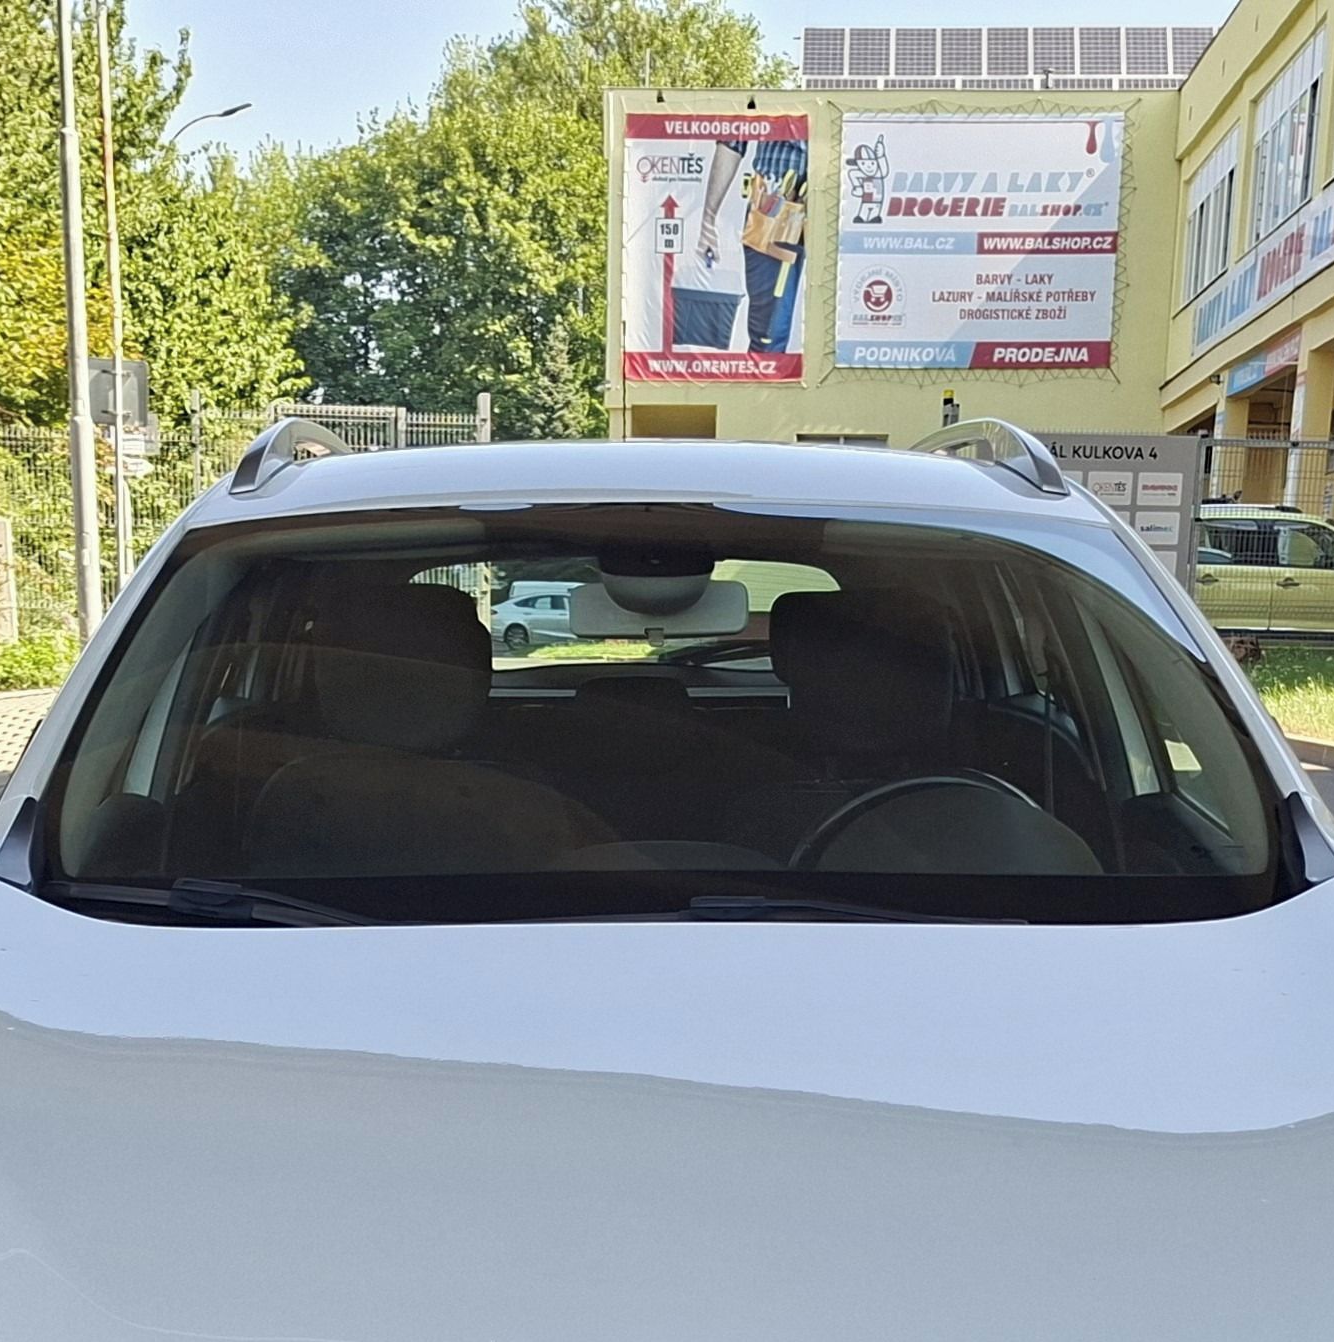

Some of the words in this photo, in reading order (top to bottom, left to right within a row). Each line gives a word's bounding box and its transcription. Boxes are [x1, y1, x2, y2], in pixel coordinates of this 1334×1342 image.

[665, 121, 770, 135] VELKOOBCHOD
[891, 172, 977, 192] BARVY
[981, 172, 998, 192] A
[1007, 172, 1084, 192] LAKY
[886, 197, 1007, 217] DROGERIE
[660, 224, 678, 235] 150
[863, 237, 955, 249] WWW.BAL.CZ
[983, 236, 1114, 250] WWW.BALSHOP.CZ
[976, 274, 1013, 285] BARVY
[1025, 274, 1054, 285] LAKY
[932, 291, 973, 303] LAZURY
[959, 306, 1031, 320] DROGISTICKÉ
[1035, 306, 1067, 320] ZBOŽÍ
[854, 344, 956, 362] PODNIKOVÁ
[993, 347, 1089, 362] PRODEJNA
[1045, 441, 1067, 458] ÁL
[1072, 445, 1144, 460] KULKOVA
[1149, 447, 1158, 460] 4
